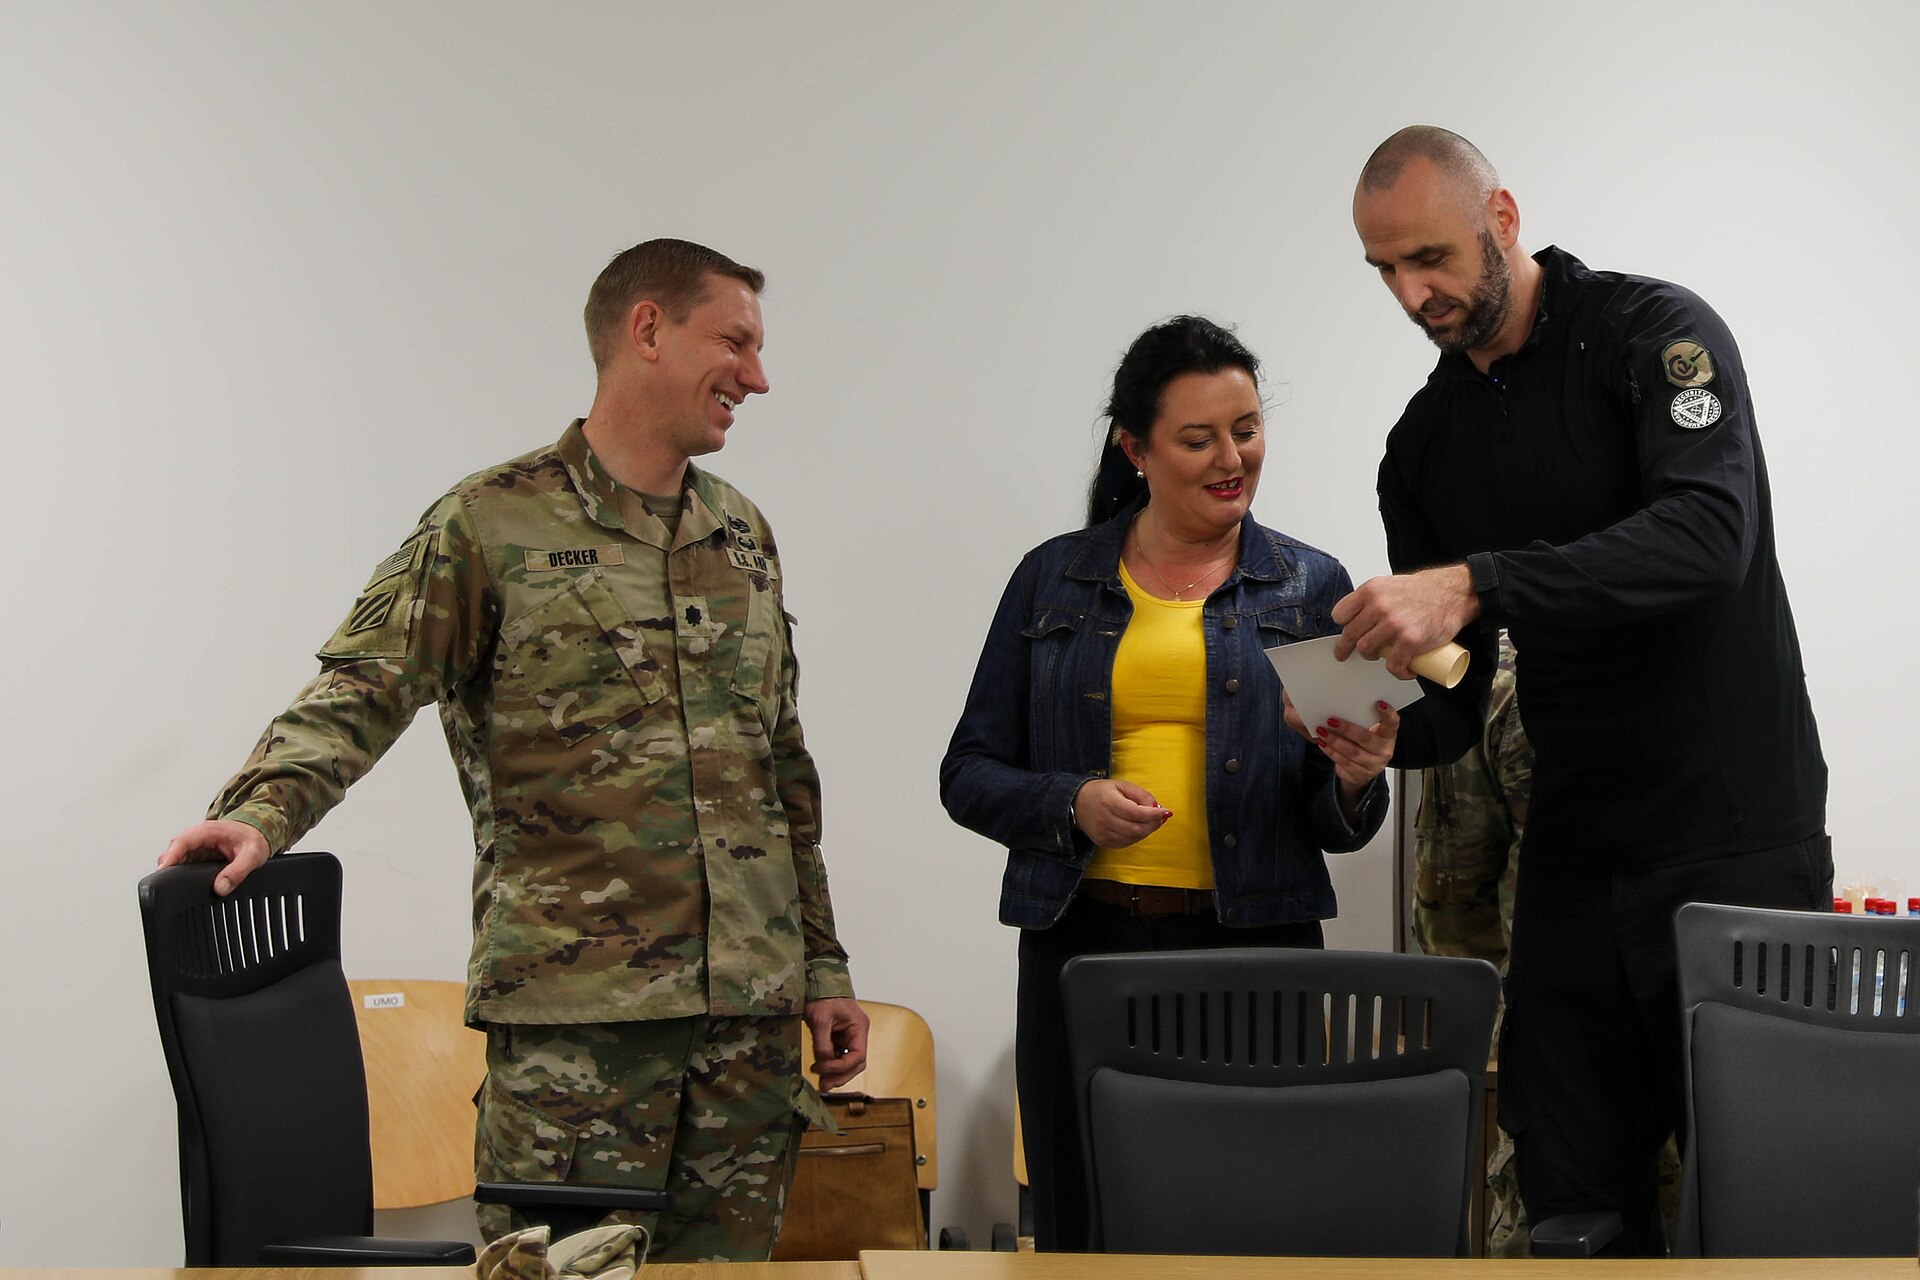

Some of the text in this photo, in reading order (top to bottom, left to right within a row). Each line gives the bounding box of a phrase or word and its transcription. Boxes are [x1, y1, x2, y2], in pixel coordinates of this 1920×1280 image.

[1674, 390, 1708, 405] SECURITY
[548, 549, 599, 568] DECKER
[372, 996, 399, 1006] UMO
